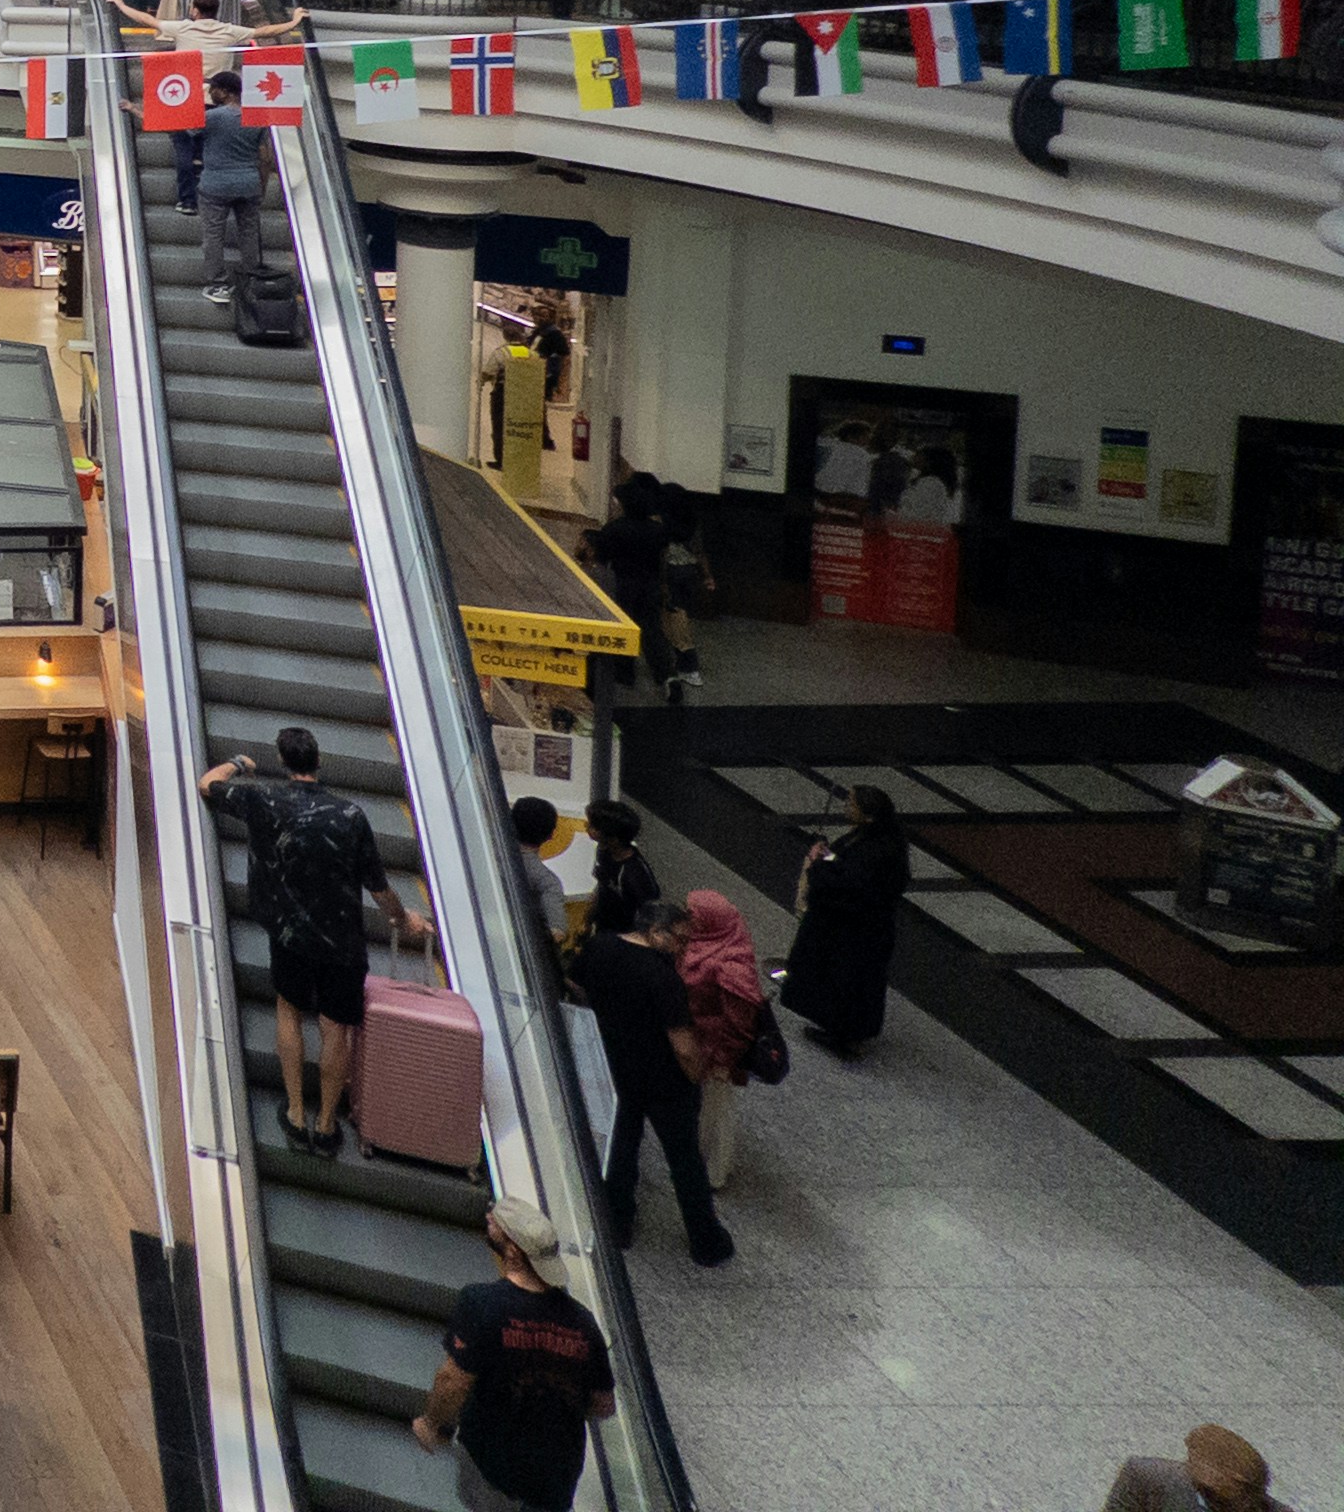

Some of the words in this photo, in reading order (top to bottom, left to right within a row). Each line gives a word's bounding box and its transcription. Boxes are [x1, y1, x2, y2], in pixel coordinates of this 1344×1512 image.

[519, 627, 551, 639] TEA
[480, 654, 540, 671] COLLECT
[543, 662, 579, 676] HERE
